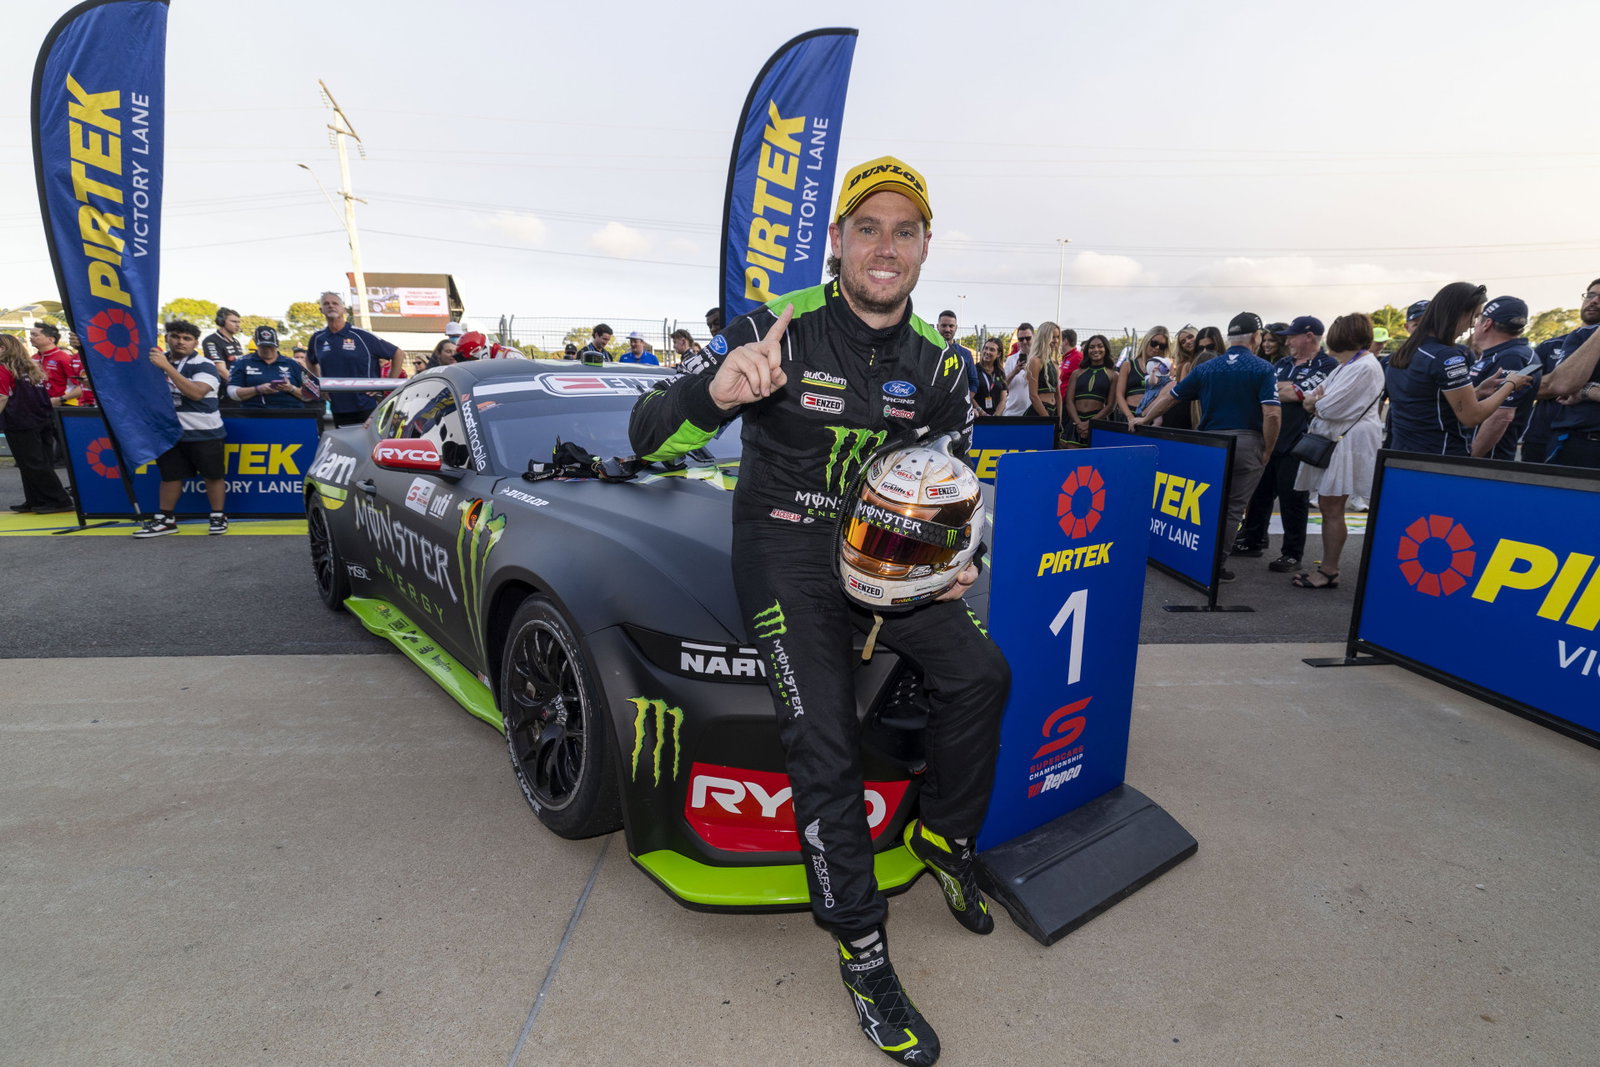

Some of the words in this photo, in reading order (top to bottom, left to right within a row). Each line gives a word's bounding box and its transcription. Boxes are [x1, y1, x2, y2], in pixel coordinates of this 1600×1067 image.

[131, 92, 149, 155] LANE
[66, 72, 132, 307] PIRTEK
[793, 176, 819, 262] VICTORY
[806, 117, 829, 170] LANE
[848, 165, 924, 192] DUNLOP
[132, 161, 149, 258] VICTORY
[744, 98, 806, 302] PIRTEK
[816, 398, 841, 410] ENZED
[888, 384, 909, 395] Ford
[890, 407, 915, 419] Castrol
[376, 448, 440, 462] RYCO
[258, 481, 303, 493] LANE
[506, 489, 549, 507] DUNLOP
[938, 486, 957, 496] ENZED
[1152, 471, 1211, 526] TEK
[807, 508, 837, 518] ENE
[858, 503, 922, 534] MONSTER
[861, 516, 909, 535] ENERGY
[355, 493, 458, 604] MONSTER
[1168, 525, 1200, 551] LANE
[1037, 541, 1114, 577] PIRTEK
[375, 556, 444, 624] ENERGY
[857, 584, 881, 596] ENZED
[1049, 588, 1088, 685] 1
[770, 653, 790, 706] ENERGY
[773, 639, 804, 718] MONSTER
[1029, 745, 1084, 773] SUPERCARS
[1029, 753, 1084, 781] CHAMPIONSHIP
[1040, 764, 1082, 793] Repco
[692, 775, 886, 828] RYO
